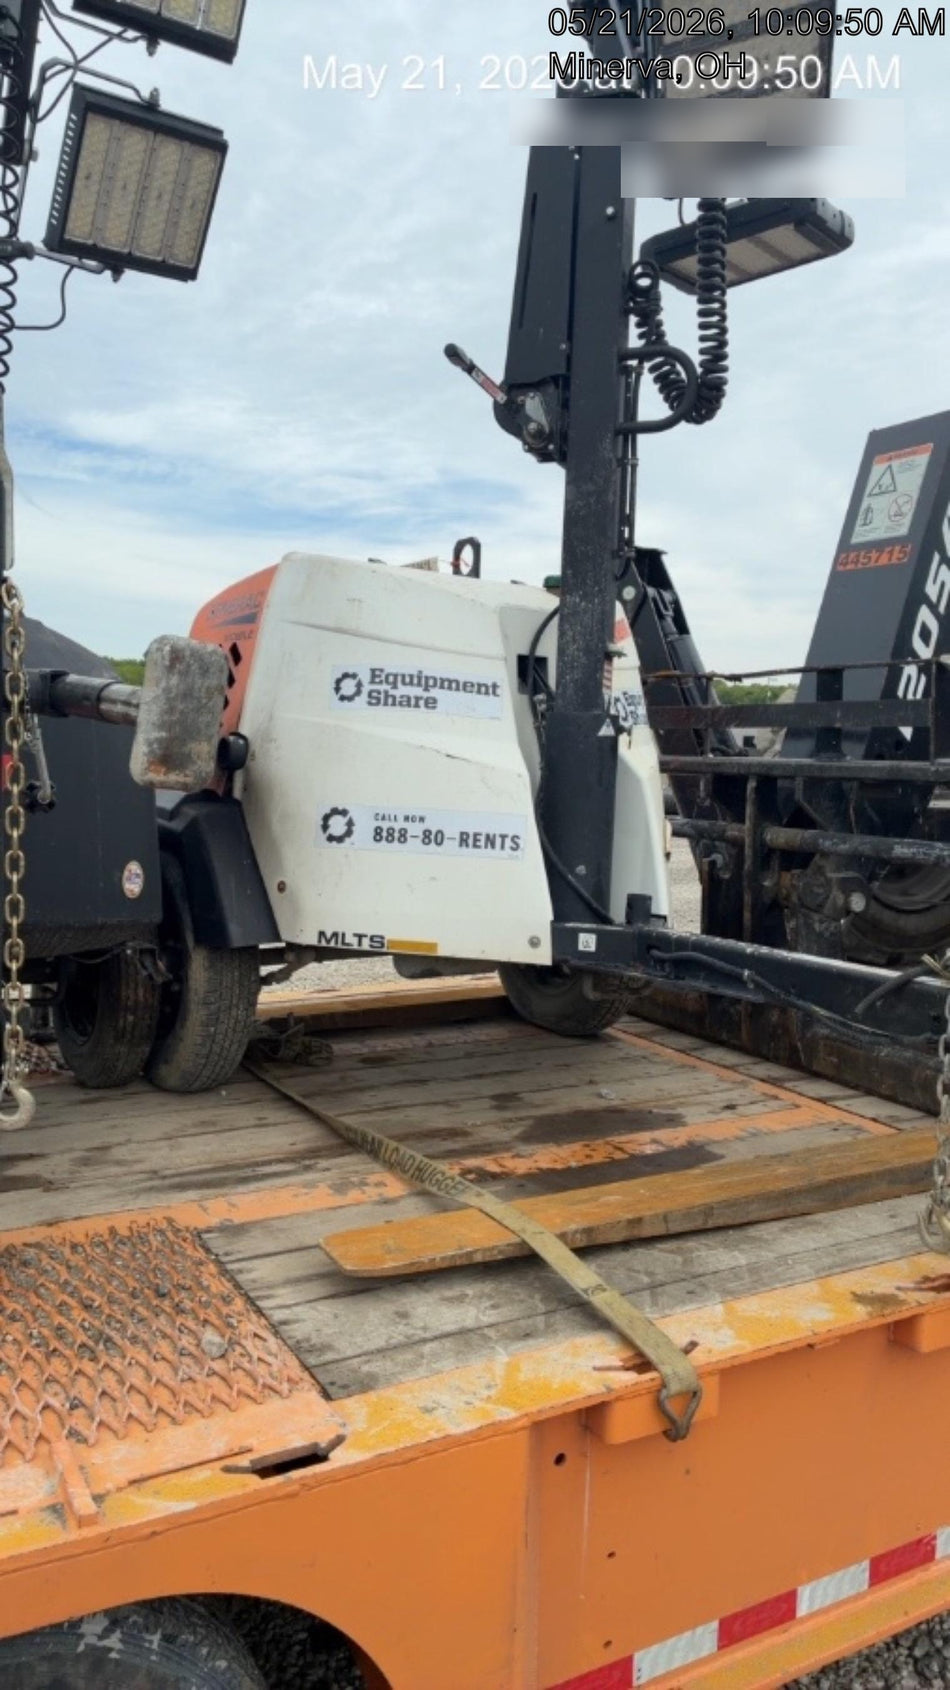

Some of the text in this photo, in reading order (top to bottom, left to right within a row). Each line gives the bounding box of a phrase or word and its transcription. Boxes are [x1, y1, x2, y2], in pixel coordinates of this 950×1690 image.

[368, 667, 501, 698] Equipment
[366, 688, 438, 711] Share
[373, 812, 427, 825] CALL NOW
[372, 825, 522, 852] 888-80-RENTS
[316, 930, 386, 950] MLTS
